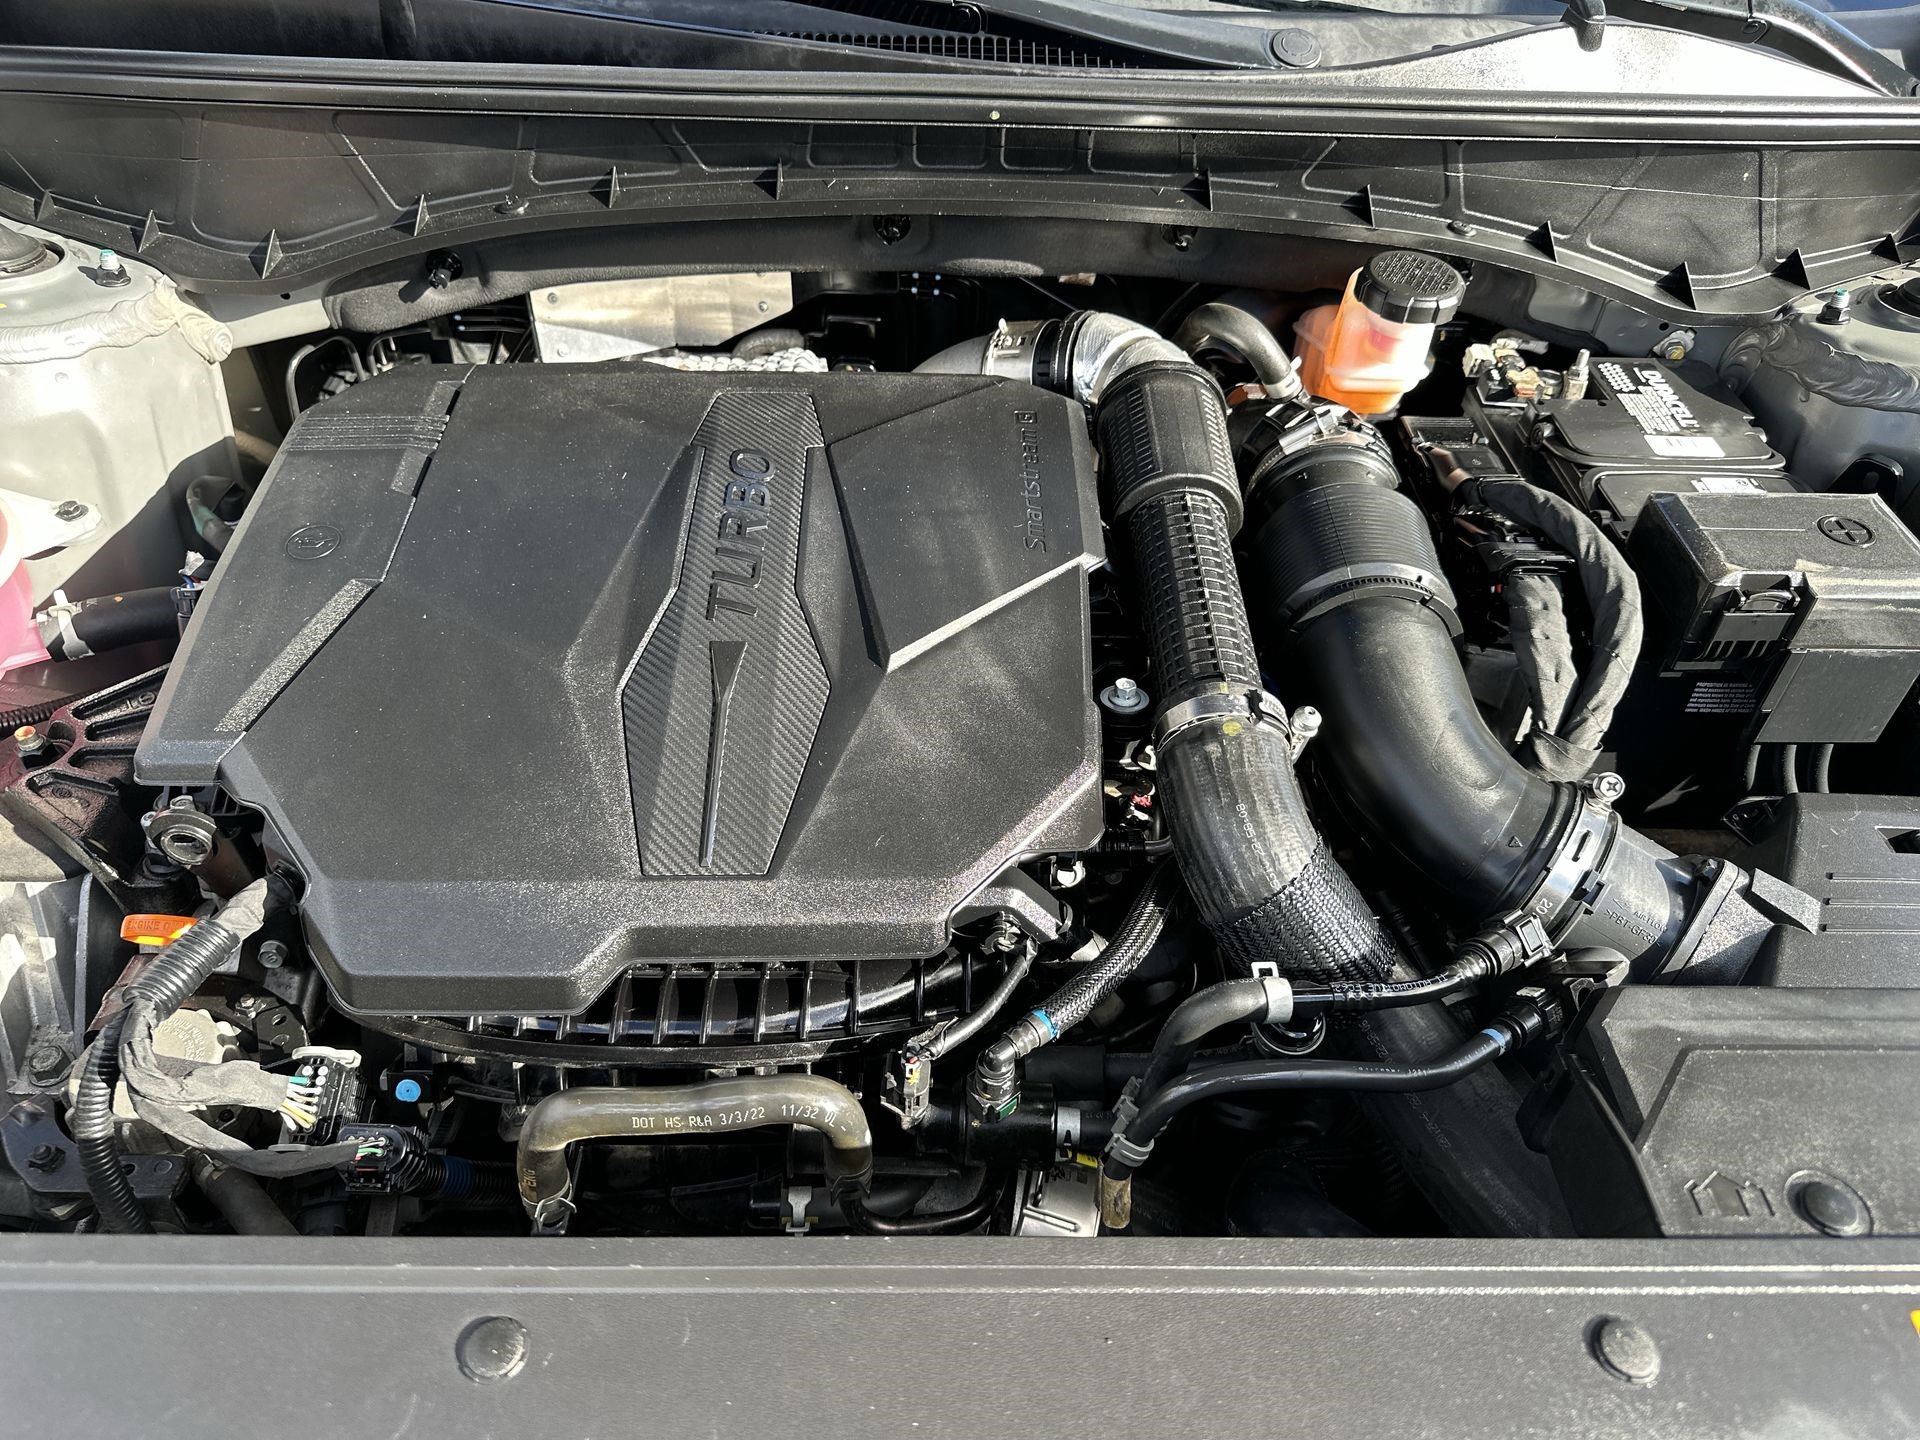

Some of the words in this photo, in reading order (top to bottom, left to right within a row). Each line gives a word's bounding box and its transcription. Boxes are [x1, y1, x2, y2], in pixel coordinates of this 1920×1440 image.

[1641, 370, 1698, 427] DURACELL
[1020, 428, 1047, 553] Smartstream
[706, 449, 776, 622] TURBO
[1535, 897, 1553, 915] 20
[1633, 911, 1647, 922] AIR
[127, 920, 159, 930] ENGINE
[632, 1116, 656, 1129] DOT
[719, 1106, 766, 1125] 3/3/22
[781, 1104, 819, 1119] 11/32
